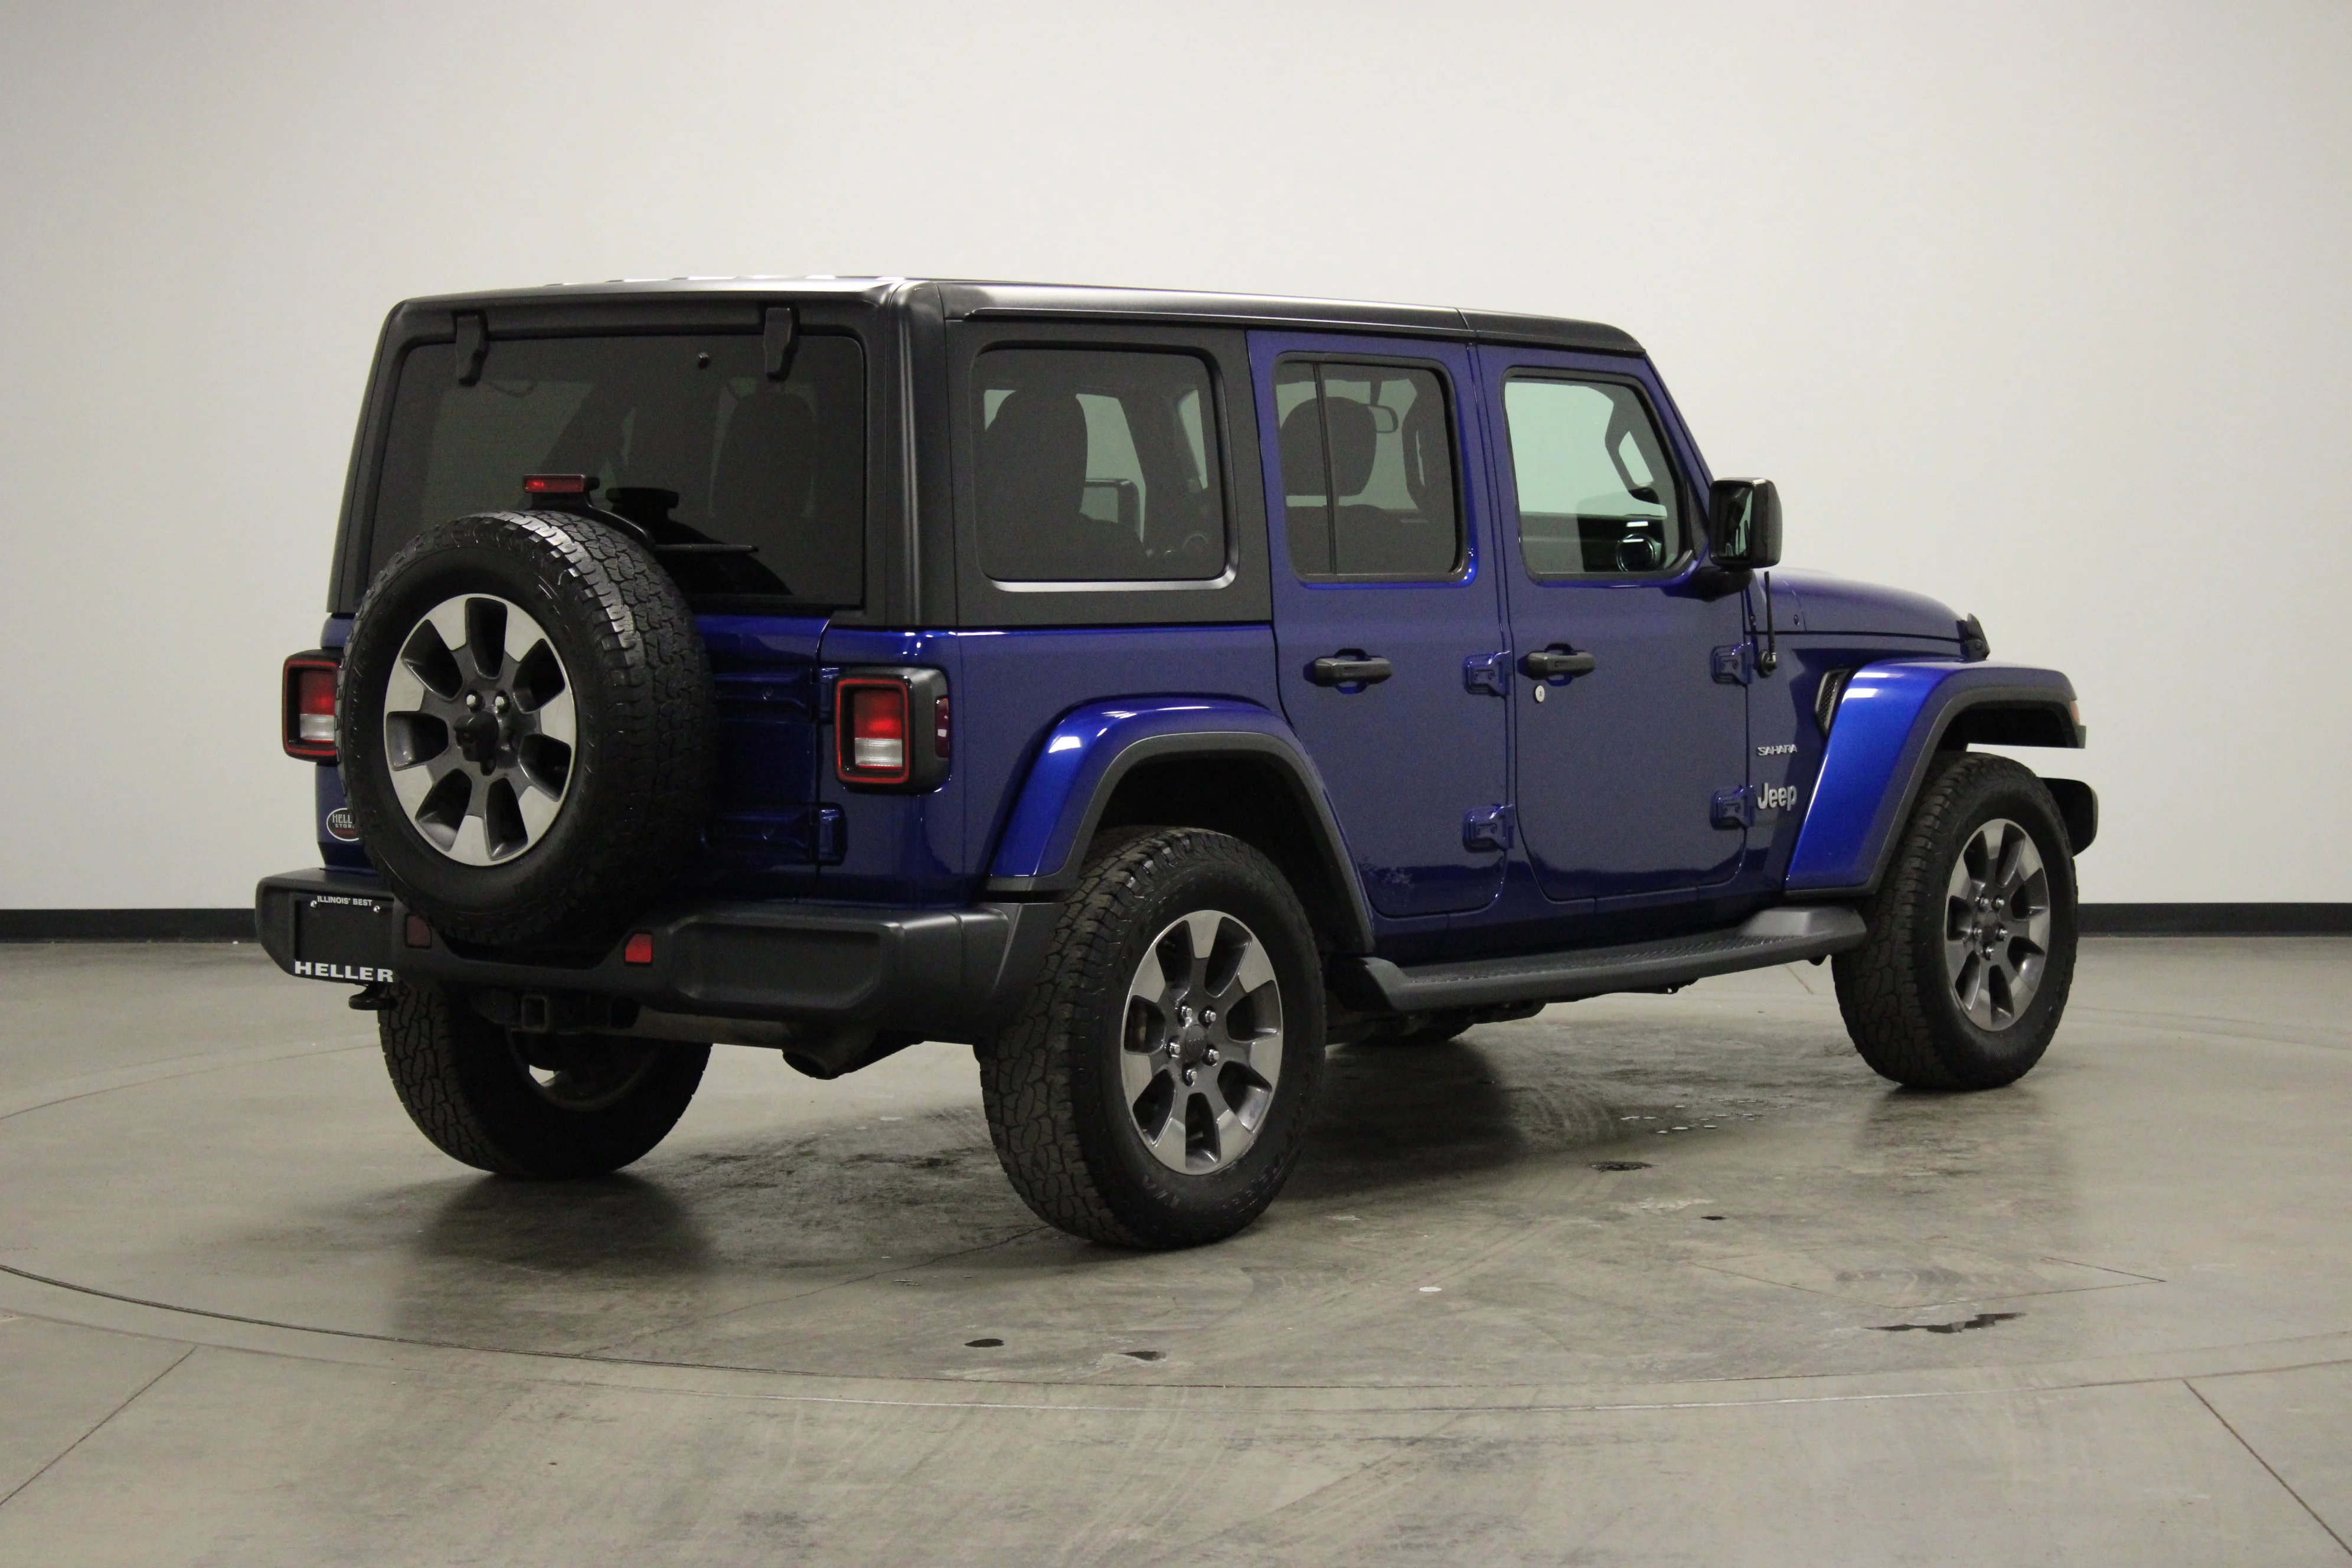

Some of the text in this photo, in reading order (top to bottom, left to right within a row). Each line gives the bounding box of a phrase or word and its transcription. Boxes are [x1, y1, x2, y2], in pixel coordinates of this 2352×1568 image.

[1758, 744, 1797, 756] SAHARA
[1758, 782, 1798, 811] Jeep
[332, 814, 352, 824] HELL
[353, 898, 373, 906] BEST
[295, 961, 393, 983] HELLER
